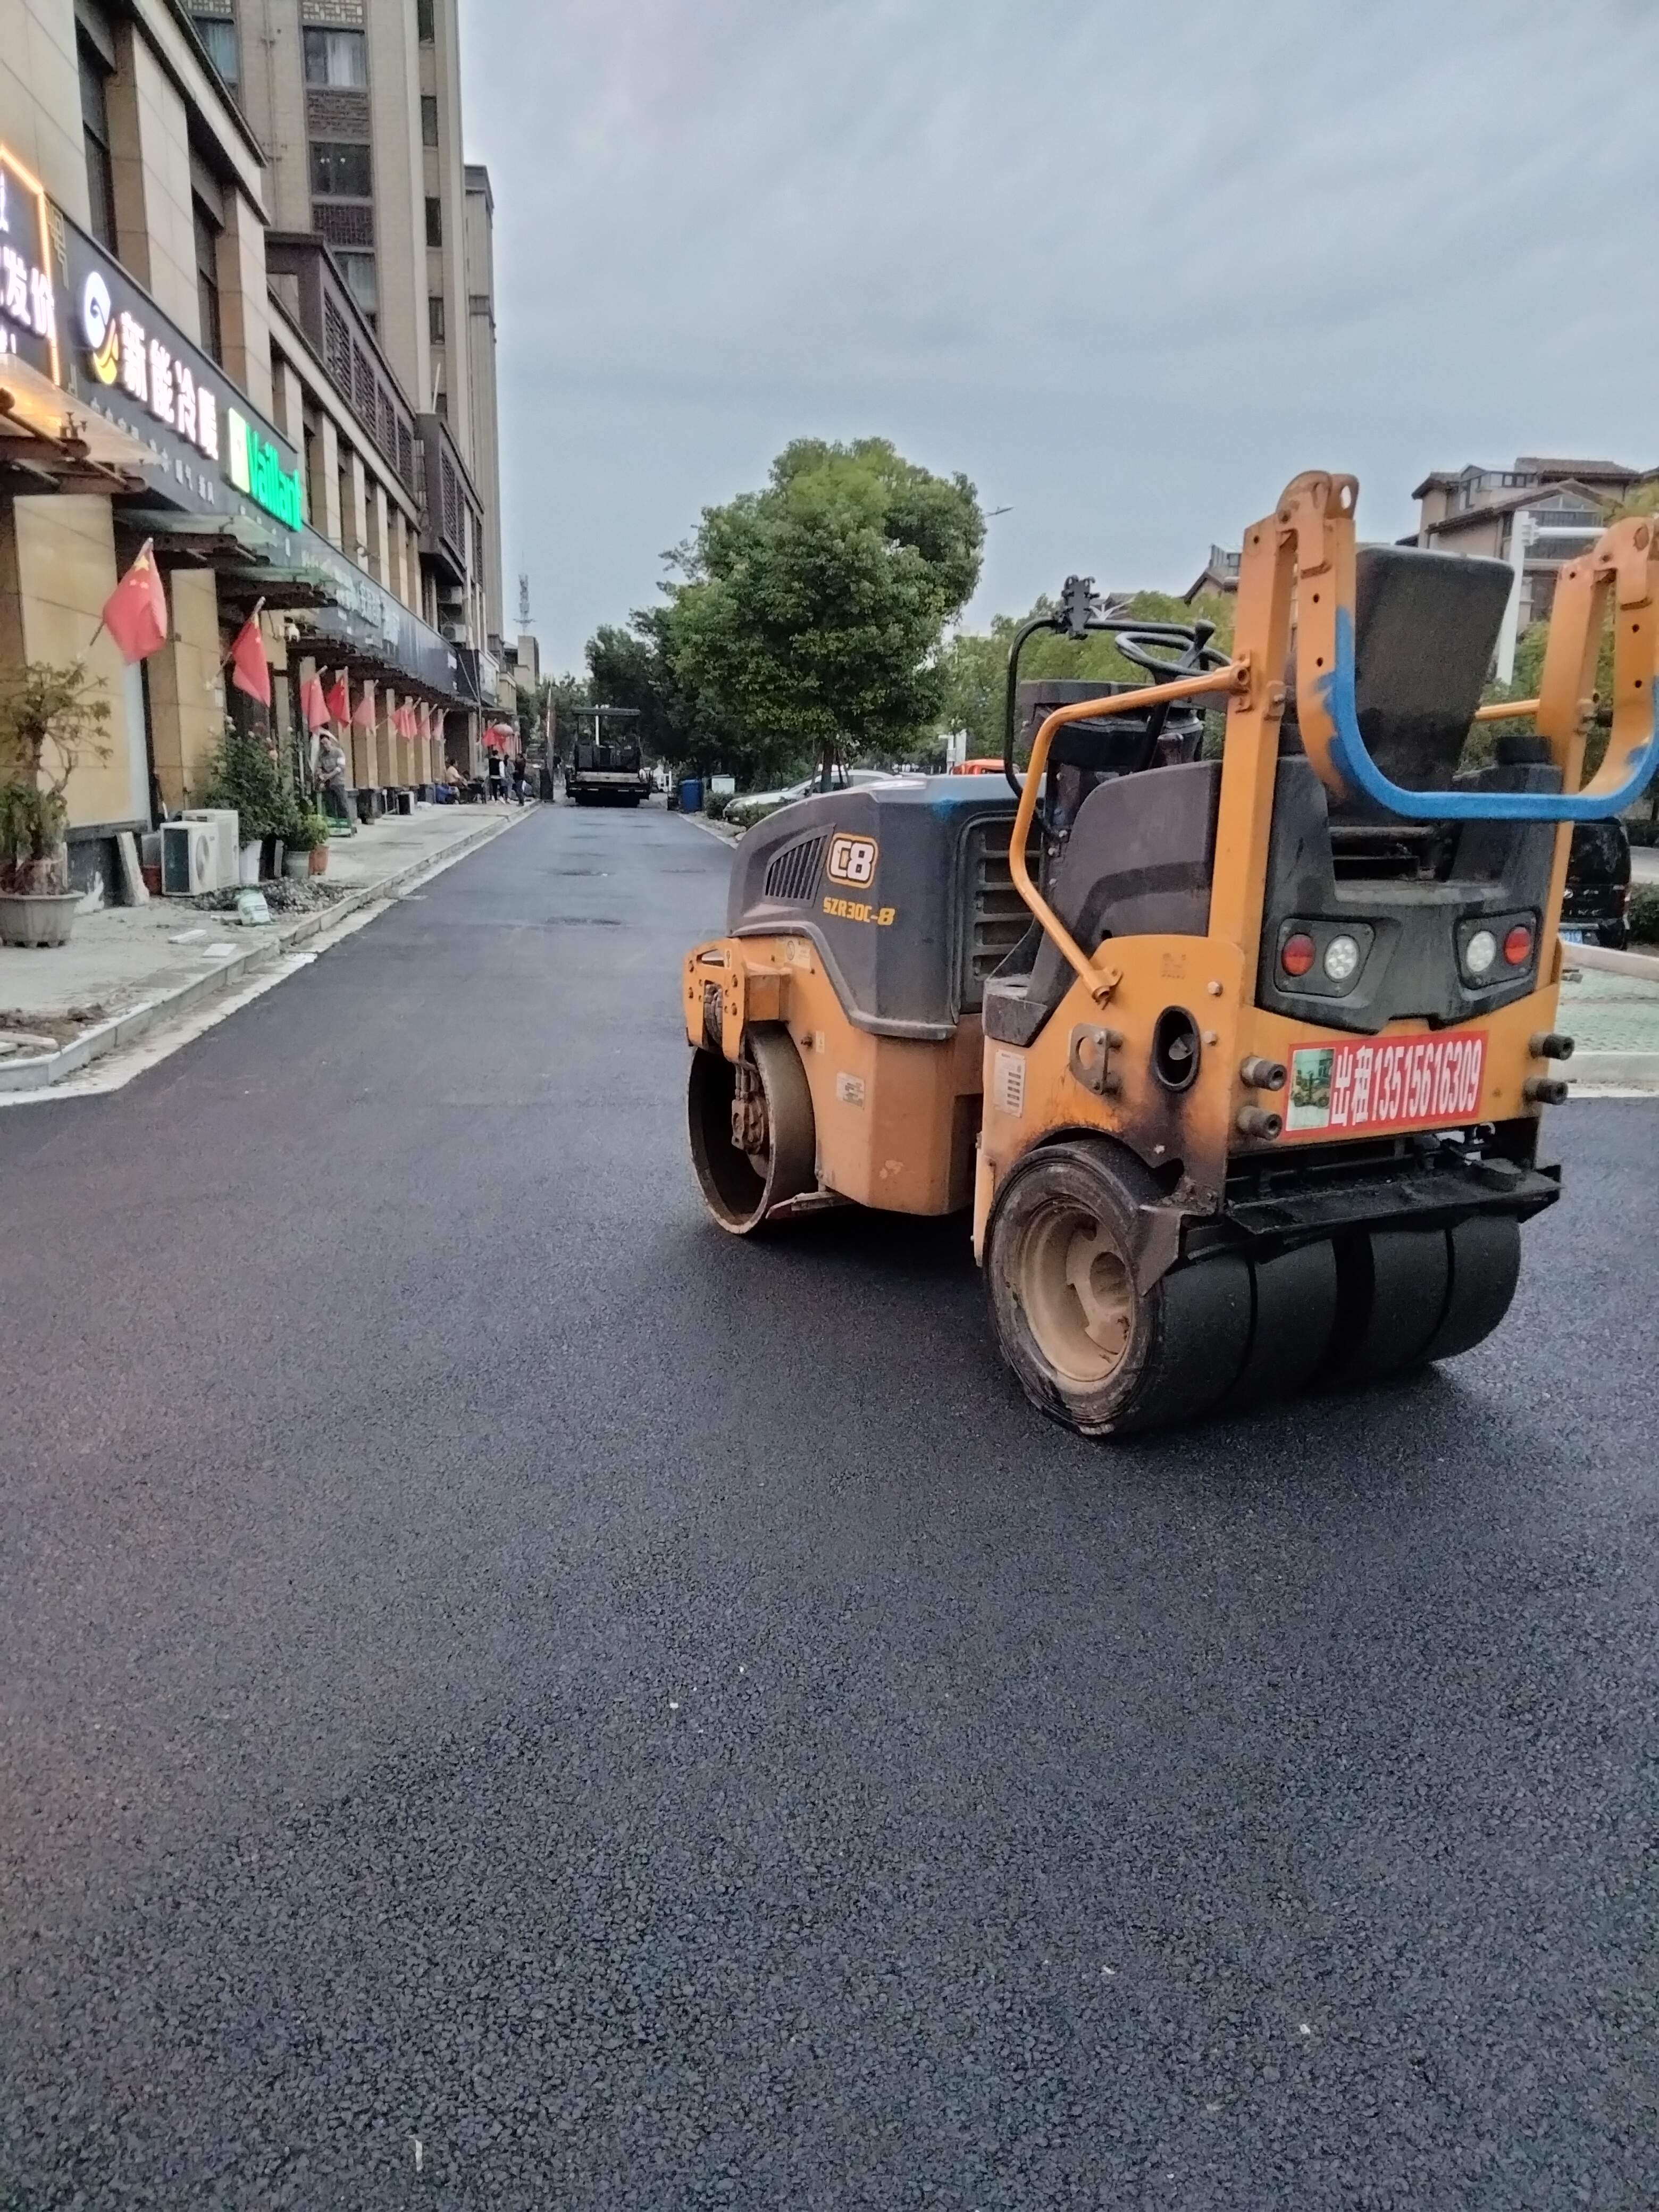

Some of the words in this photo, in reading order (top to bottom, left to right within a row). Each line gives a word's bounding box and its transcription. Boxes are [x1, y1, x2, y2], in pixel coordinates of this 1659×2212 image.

[0, 245, 55, 339] 发价
[246, 423, 302, 532] Vaillant
[829, 838, 876, 883] C8
[823, 896, 895, 926] SZR30C-8
